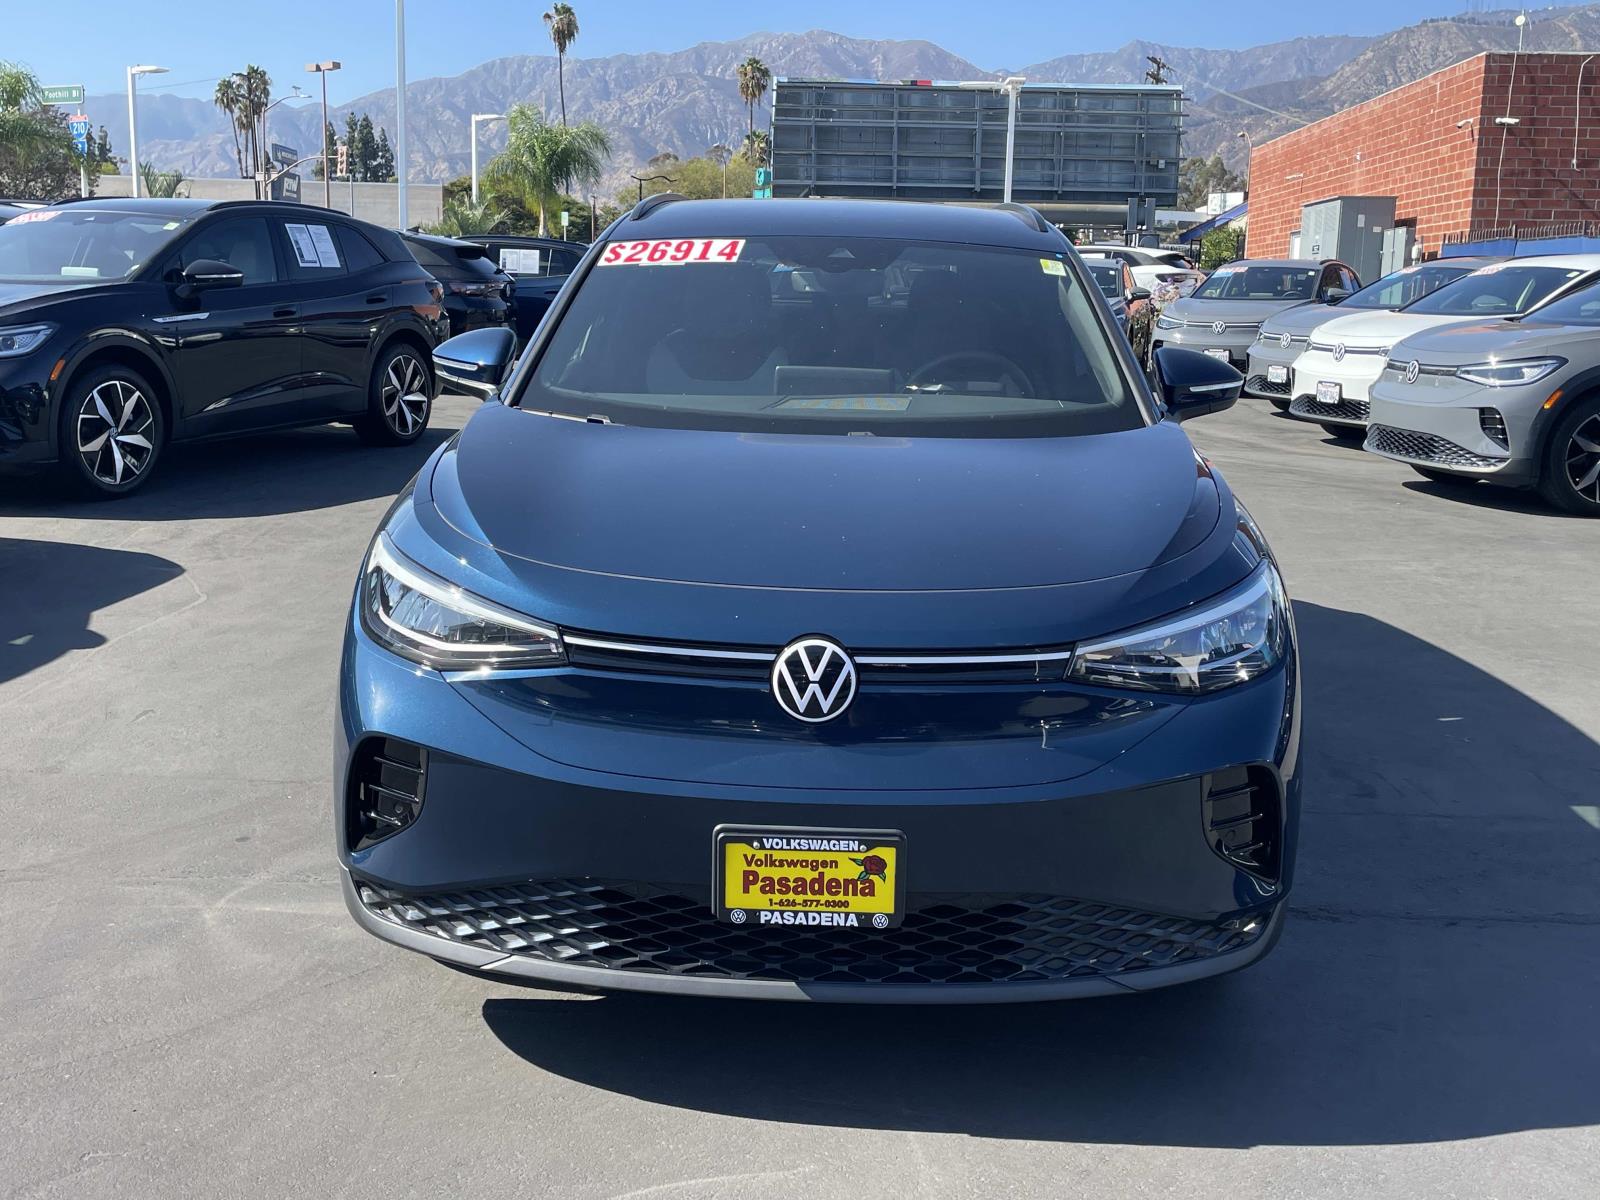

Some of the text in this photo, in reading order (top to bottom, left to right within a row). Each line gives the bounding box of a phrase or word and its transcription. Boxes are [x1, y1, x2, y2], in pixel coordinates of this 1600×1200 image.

[44, 90, 69, 99] Foothill
[73, 122, 85, 134] 210
[604, 240, 741, 263] $26914
[773, 639, 856, 722] VW
[762, 838, 859, 851] VOLKSWAGEN
[743, 854, 839, 871] Volkswagen
[742, 870, 876, 897] Pasadena
[768, 898, 850, 908] 1-626-577-0300
[760, 911, 859, 927] PASADENA
